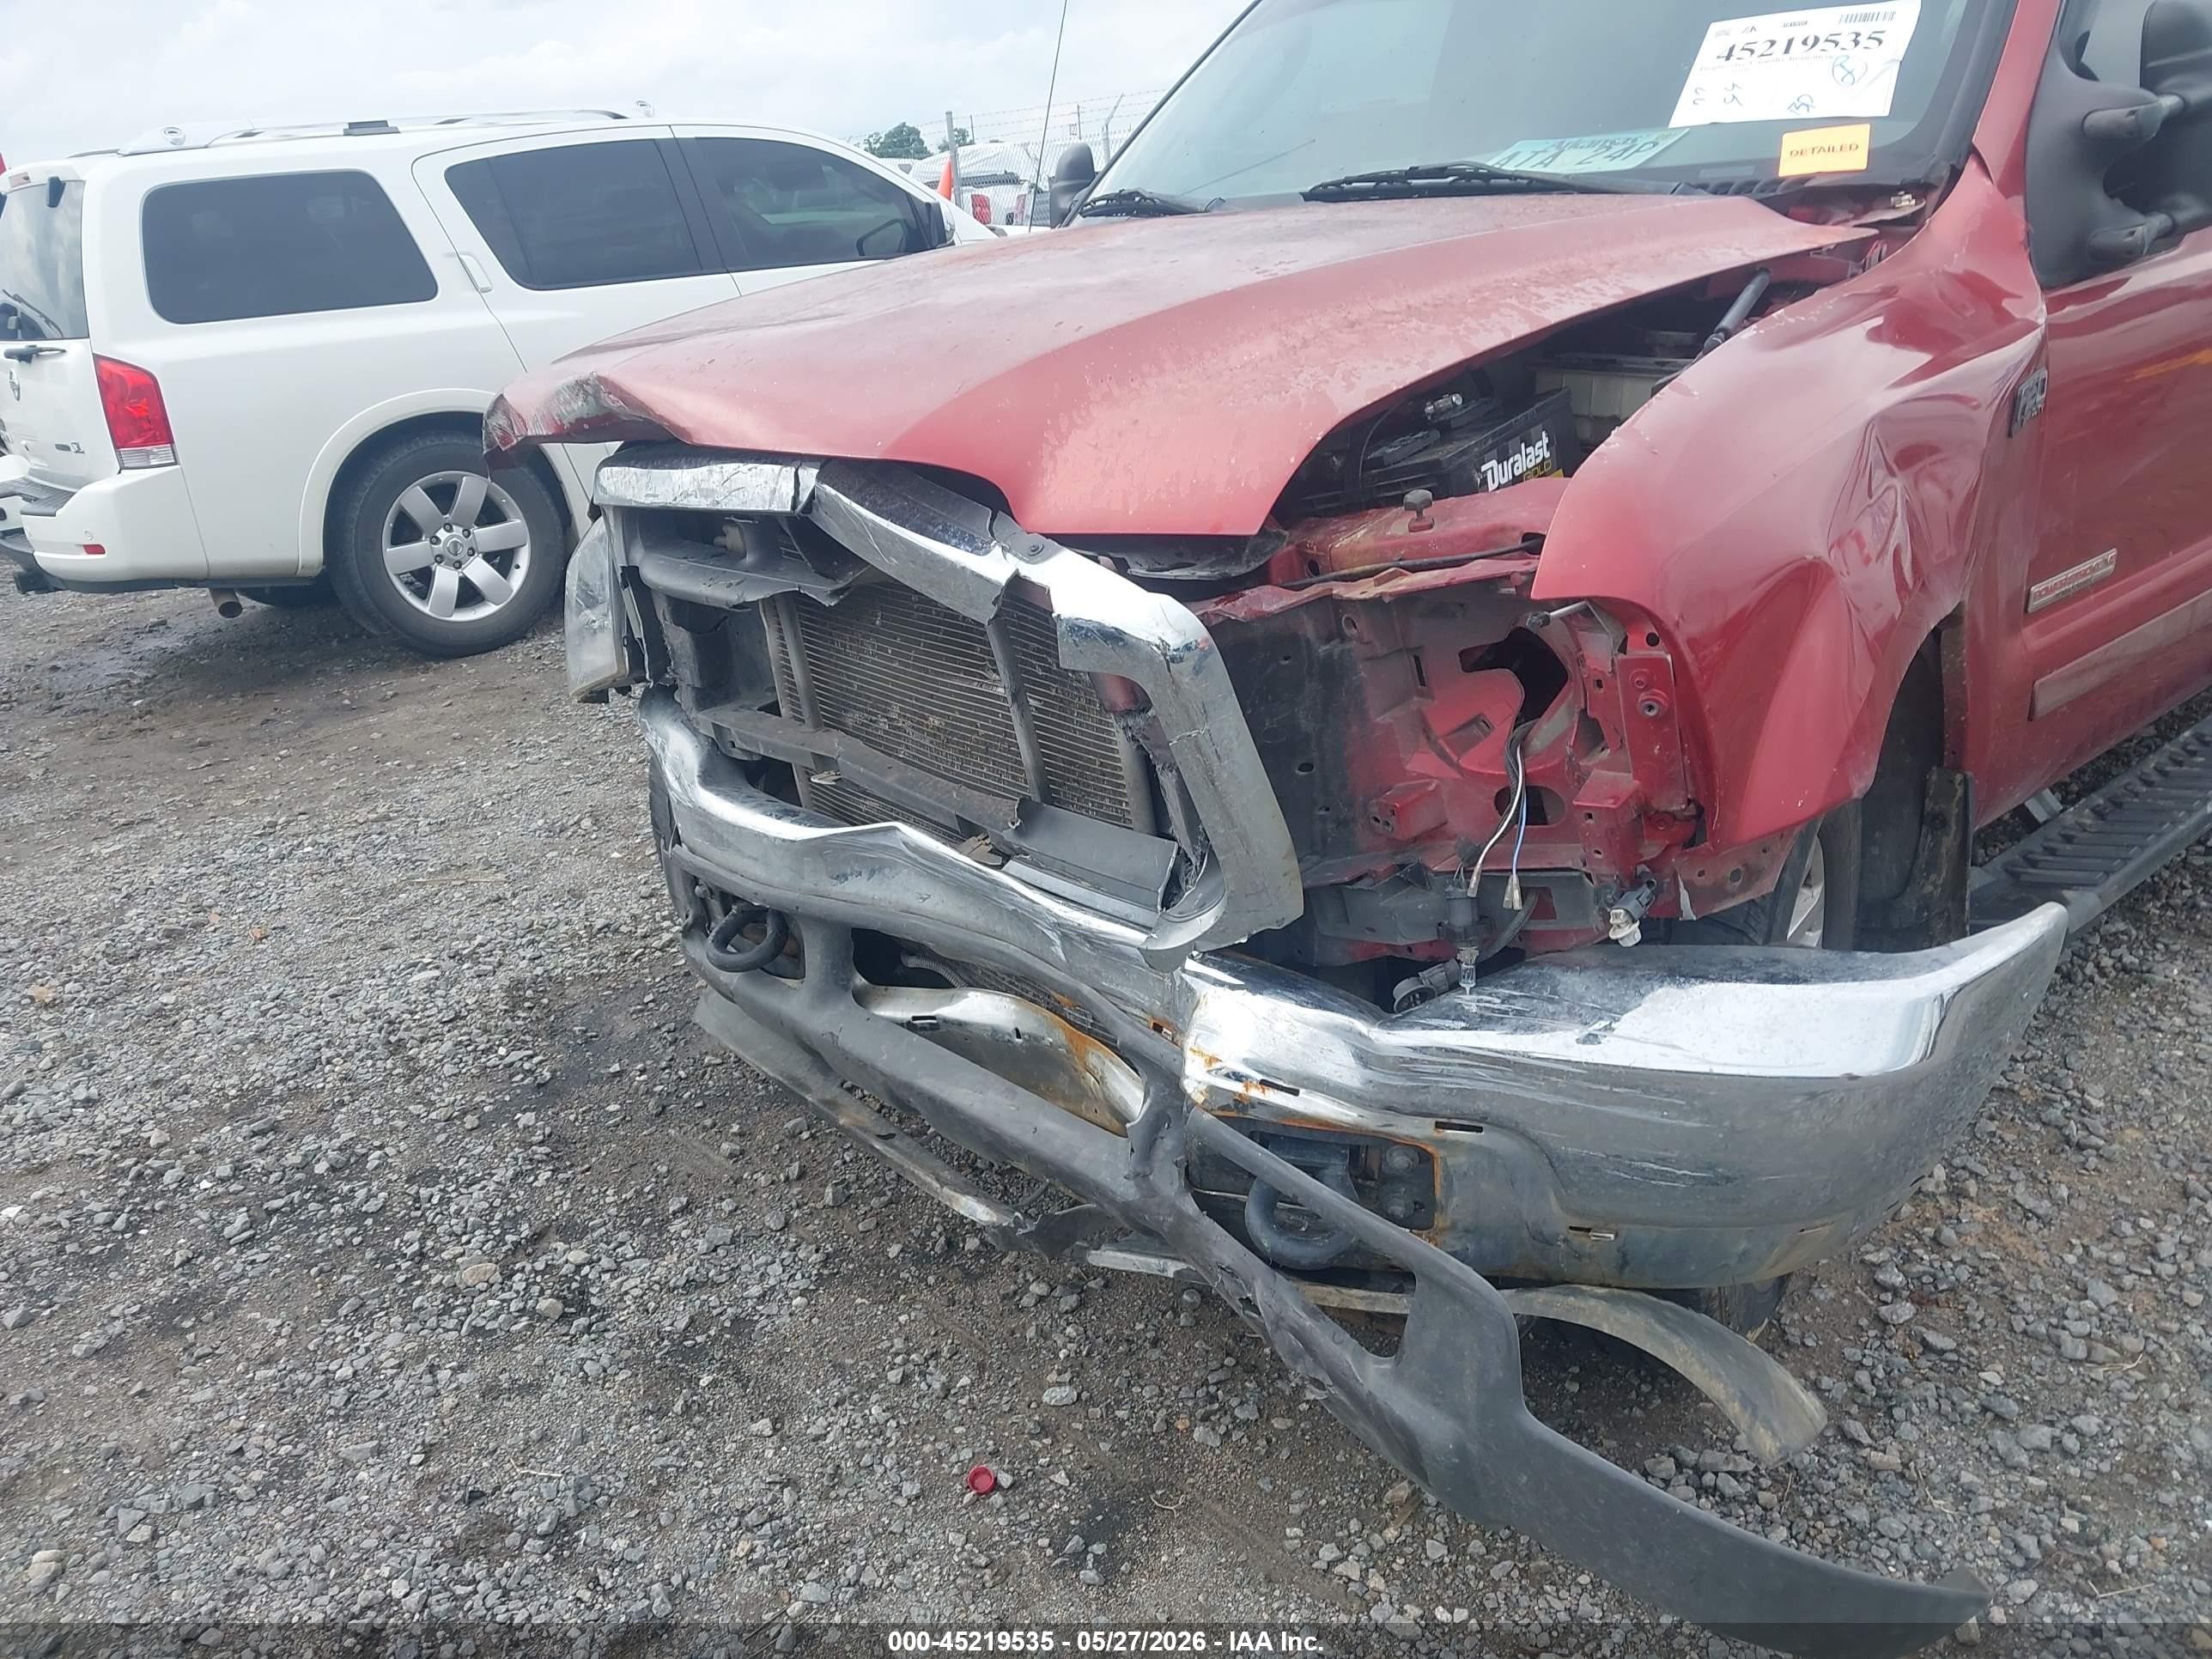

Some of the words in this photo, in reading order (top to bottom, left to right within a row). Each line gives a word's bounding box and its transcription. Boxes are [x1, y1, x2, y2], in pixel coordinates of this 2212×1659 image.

[1717, 30, 1887, 62] 45219535
[1789, 143, 1860, 158] DETAILED
[1480, 430, 1551, 493] Duralast
[1523, 459, 1552, 482] GOLD
